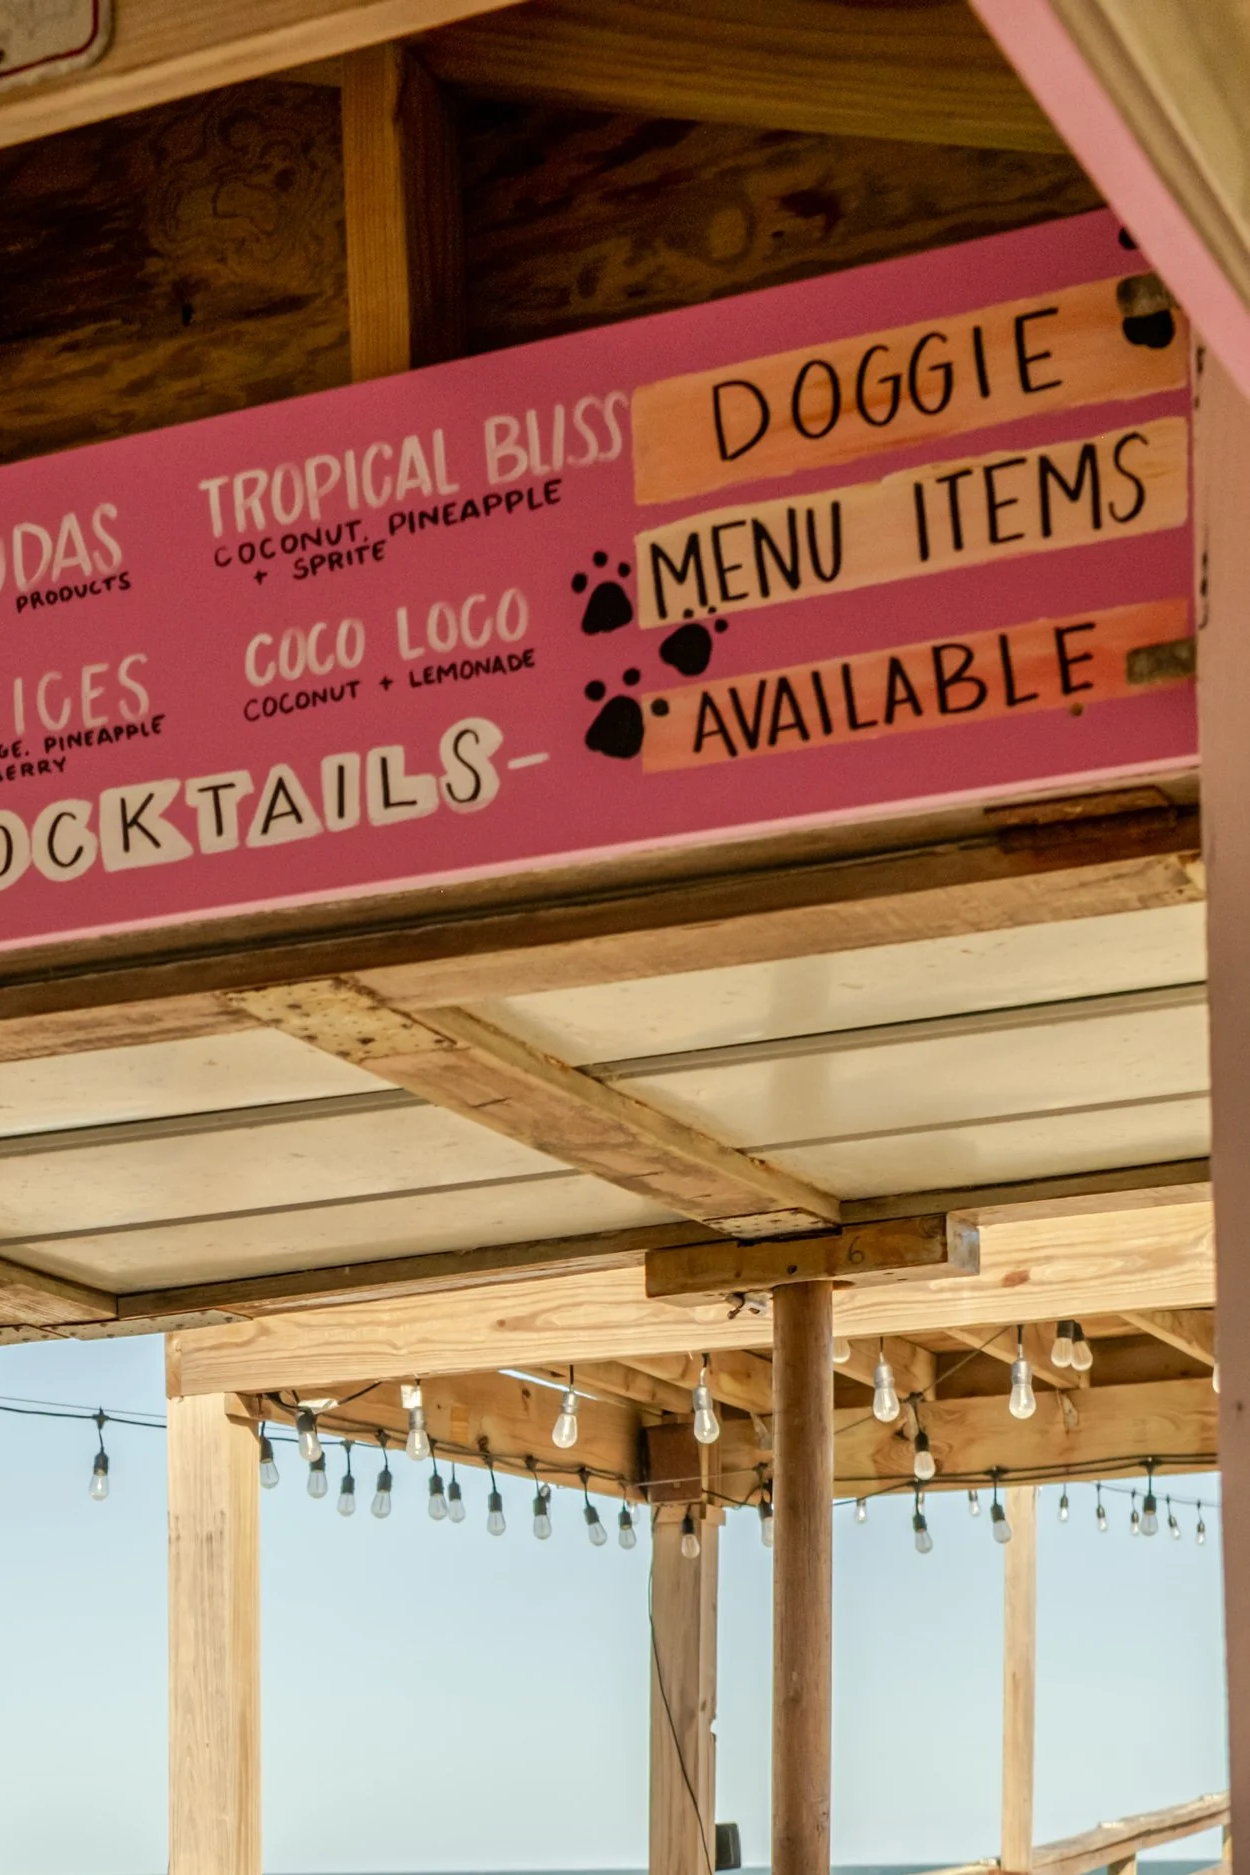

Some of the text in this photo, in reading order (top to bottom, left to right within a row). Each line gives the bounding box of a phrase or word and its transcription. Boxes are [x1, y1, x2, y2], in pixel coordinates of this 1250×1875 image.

[712, 307, 1064, 461] DOGGIE
[198, 391, 630, 538] TROPICAL BLISS
[388, 479, 562, 536] PINEAPPLE
[292, 540, 386, 580] SPRITE
[650, 432, 1148, 619] MENU ITEMS
[16, 571, 131, 614] PRODUCTS
[245, 588, 529, 687] COCO LOCO
[244, 680, 361, 722] COCONUT
[410, 648, 536, 688] LEMONADE
[693, 621, 1097, 758] AVAILABLE
[44, 714, 165, 753] PINEAPPLE
